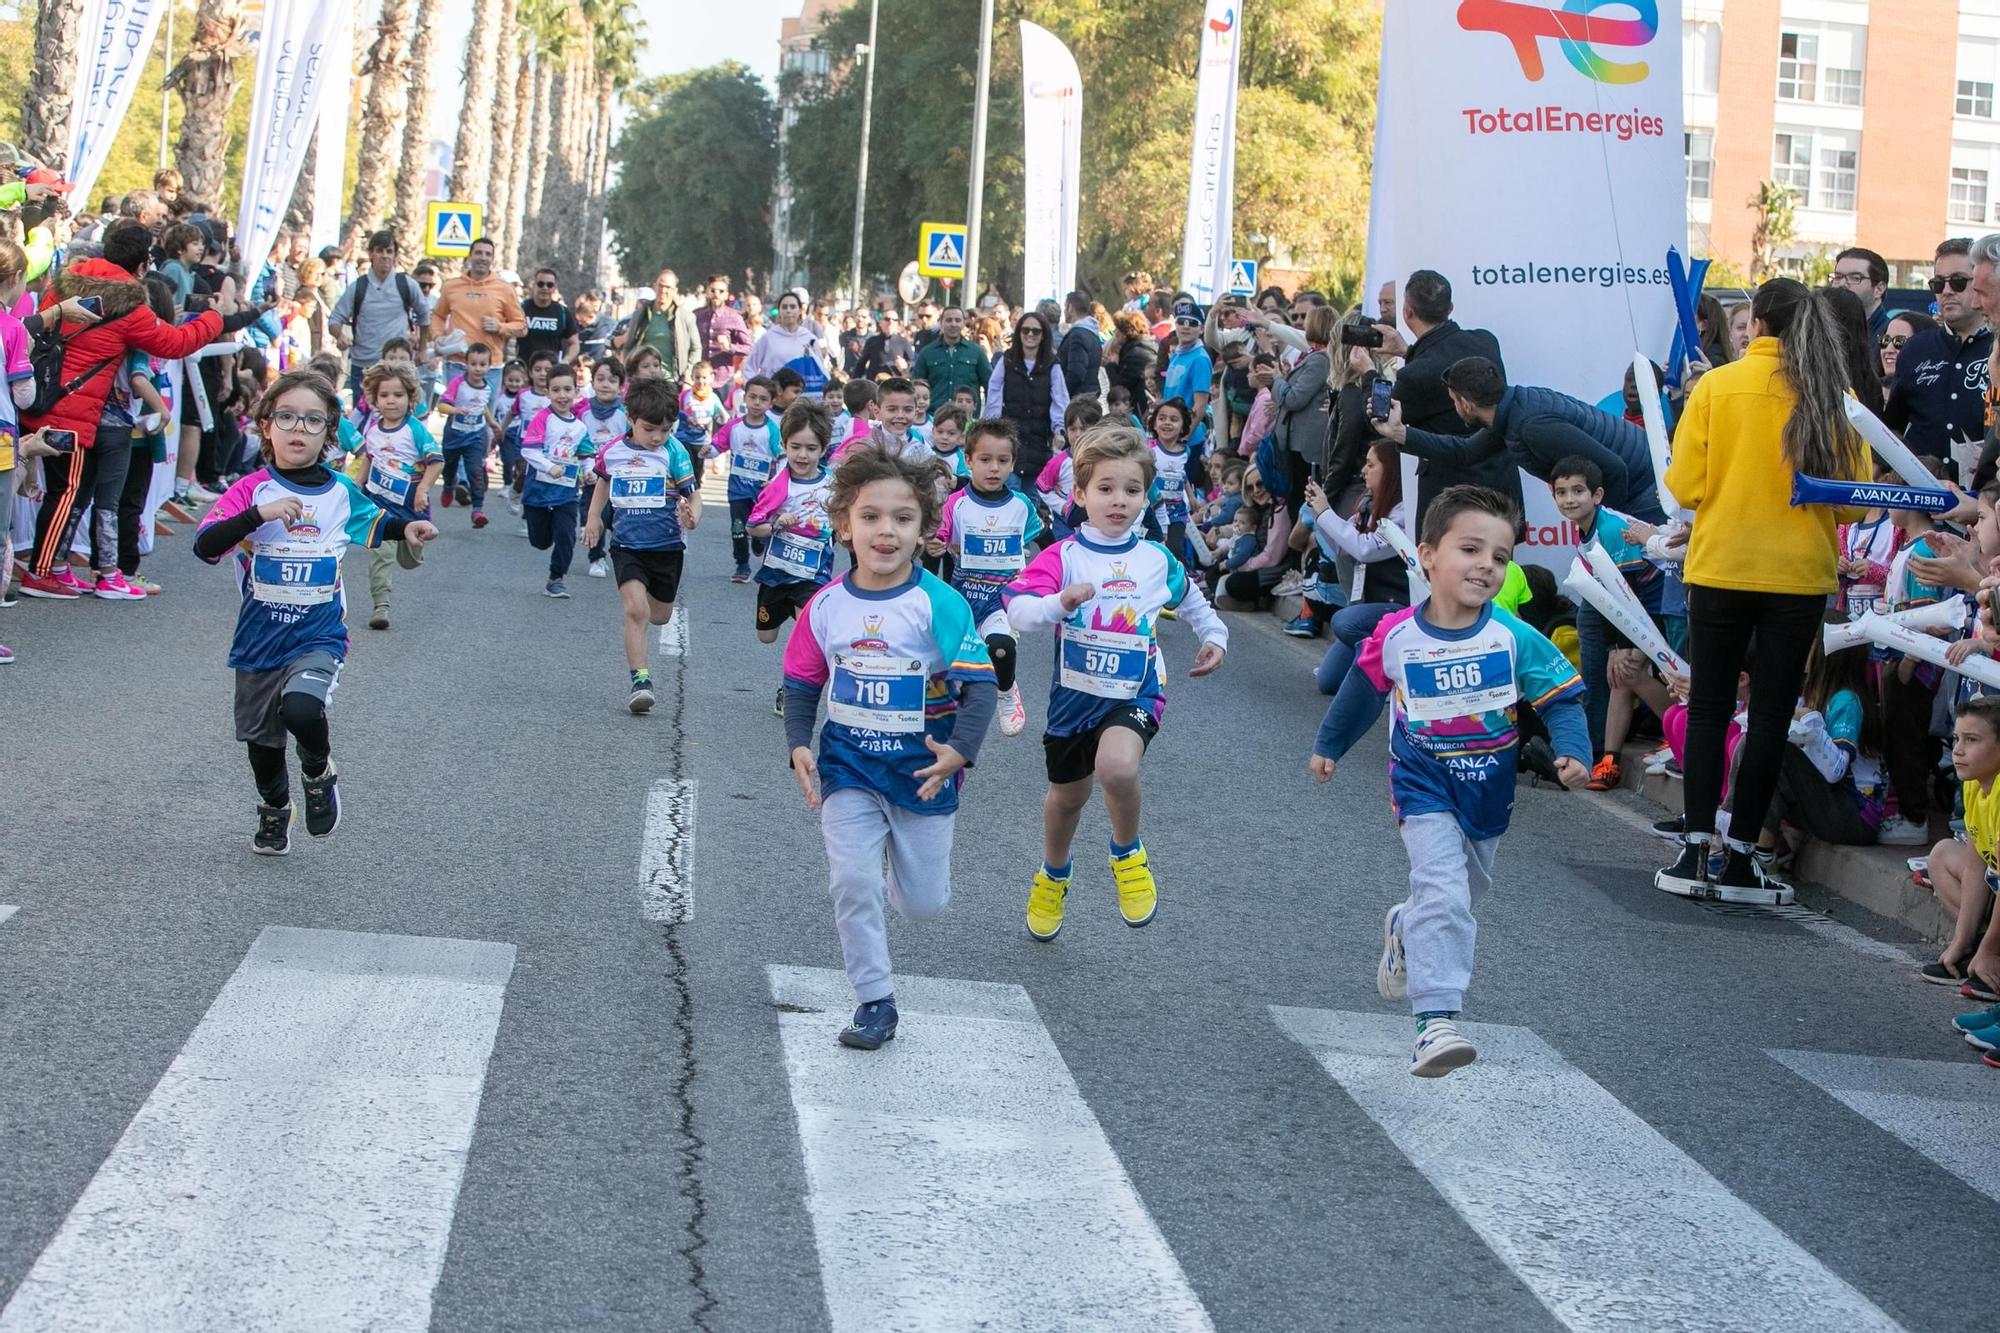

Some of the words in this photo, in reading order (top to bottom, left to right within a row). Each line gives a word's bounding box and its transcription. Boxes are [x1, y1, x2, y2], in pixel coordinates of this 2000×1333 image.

[1462, 106, 1664, 141] TotalEnergies
[1472, 262, 1670, 288] totalenergies.es
[526, 316, 558, 331] VANS
[627, 480, 647, 493] 737
[1850, 488, 1912, 503] AVANZA
[1914, 495, 1946, 506] FIBRA
[782, 545, 806, 563] 565
[983, 539, 1007, 554] 574
[281, 562, 313, 583] 577
[1085, 650, 1120, 675] 579
[1434, 662, 1483, 691] 566
[856, 680, 890, 705] 719
[1434, 742, 1466, 751] MURCIA
[1446, 755, 1500, 771] ANZA
[1450, 768, 1488, 782] BRA
